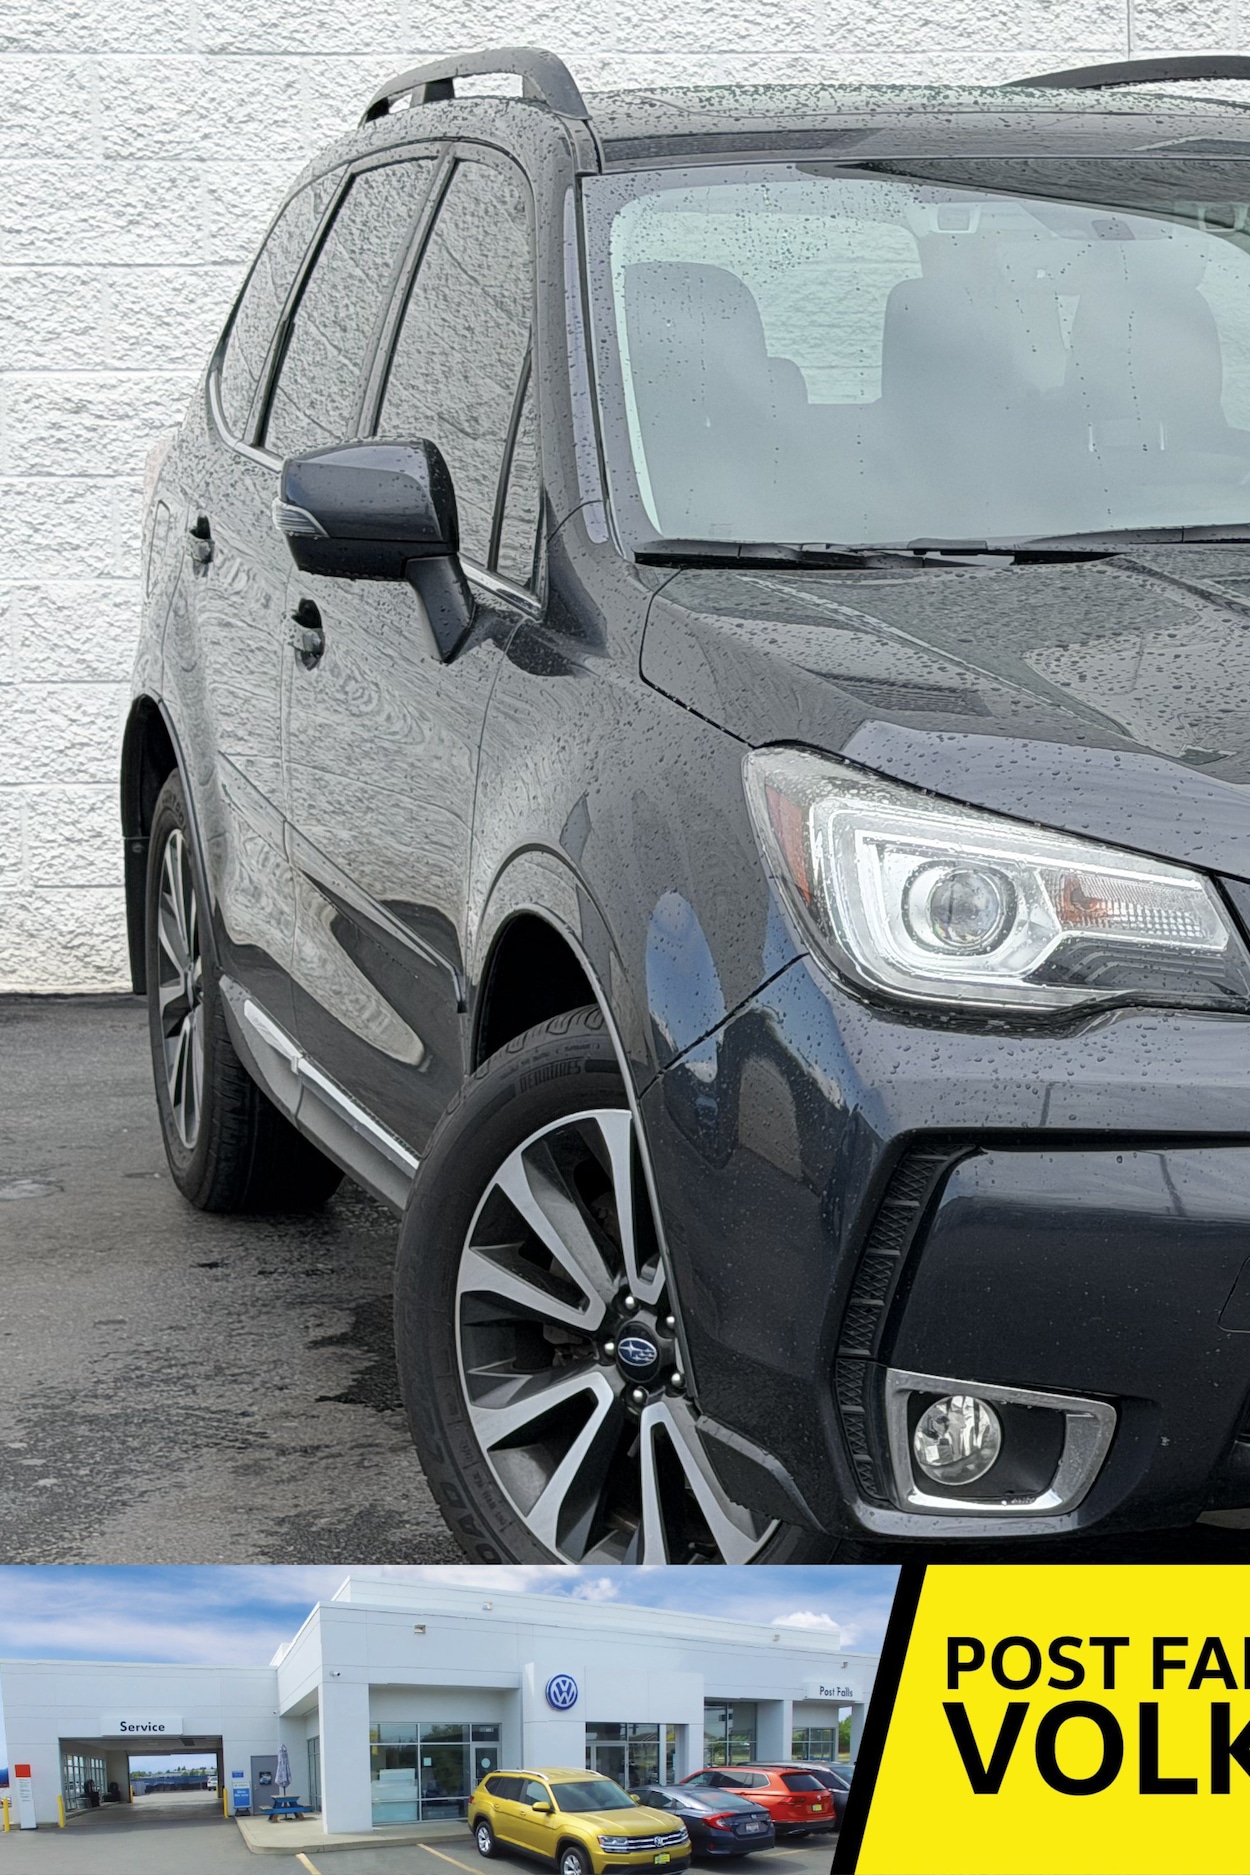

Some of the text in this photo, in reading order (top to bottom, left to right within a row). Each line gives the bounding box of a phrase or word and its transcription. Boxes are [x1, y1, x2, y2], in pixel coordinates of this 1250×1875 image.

[819, 1685, 854, 1698] Post Falls
[120, 1721, 165, 1732] Service
